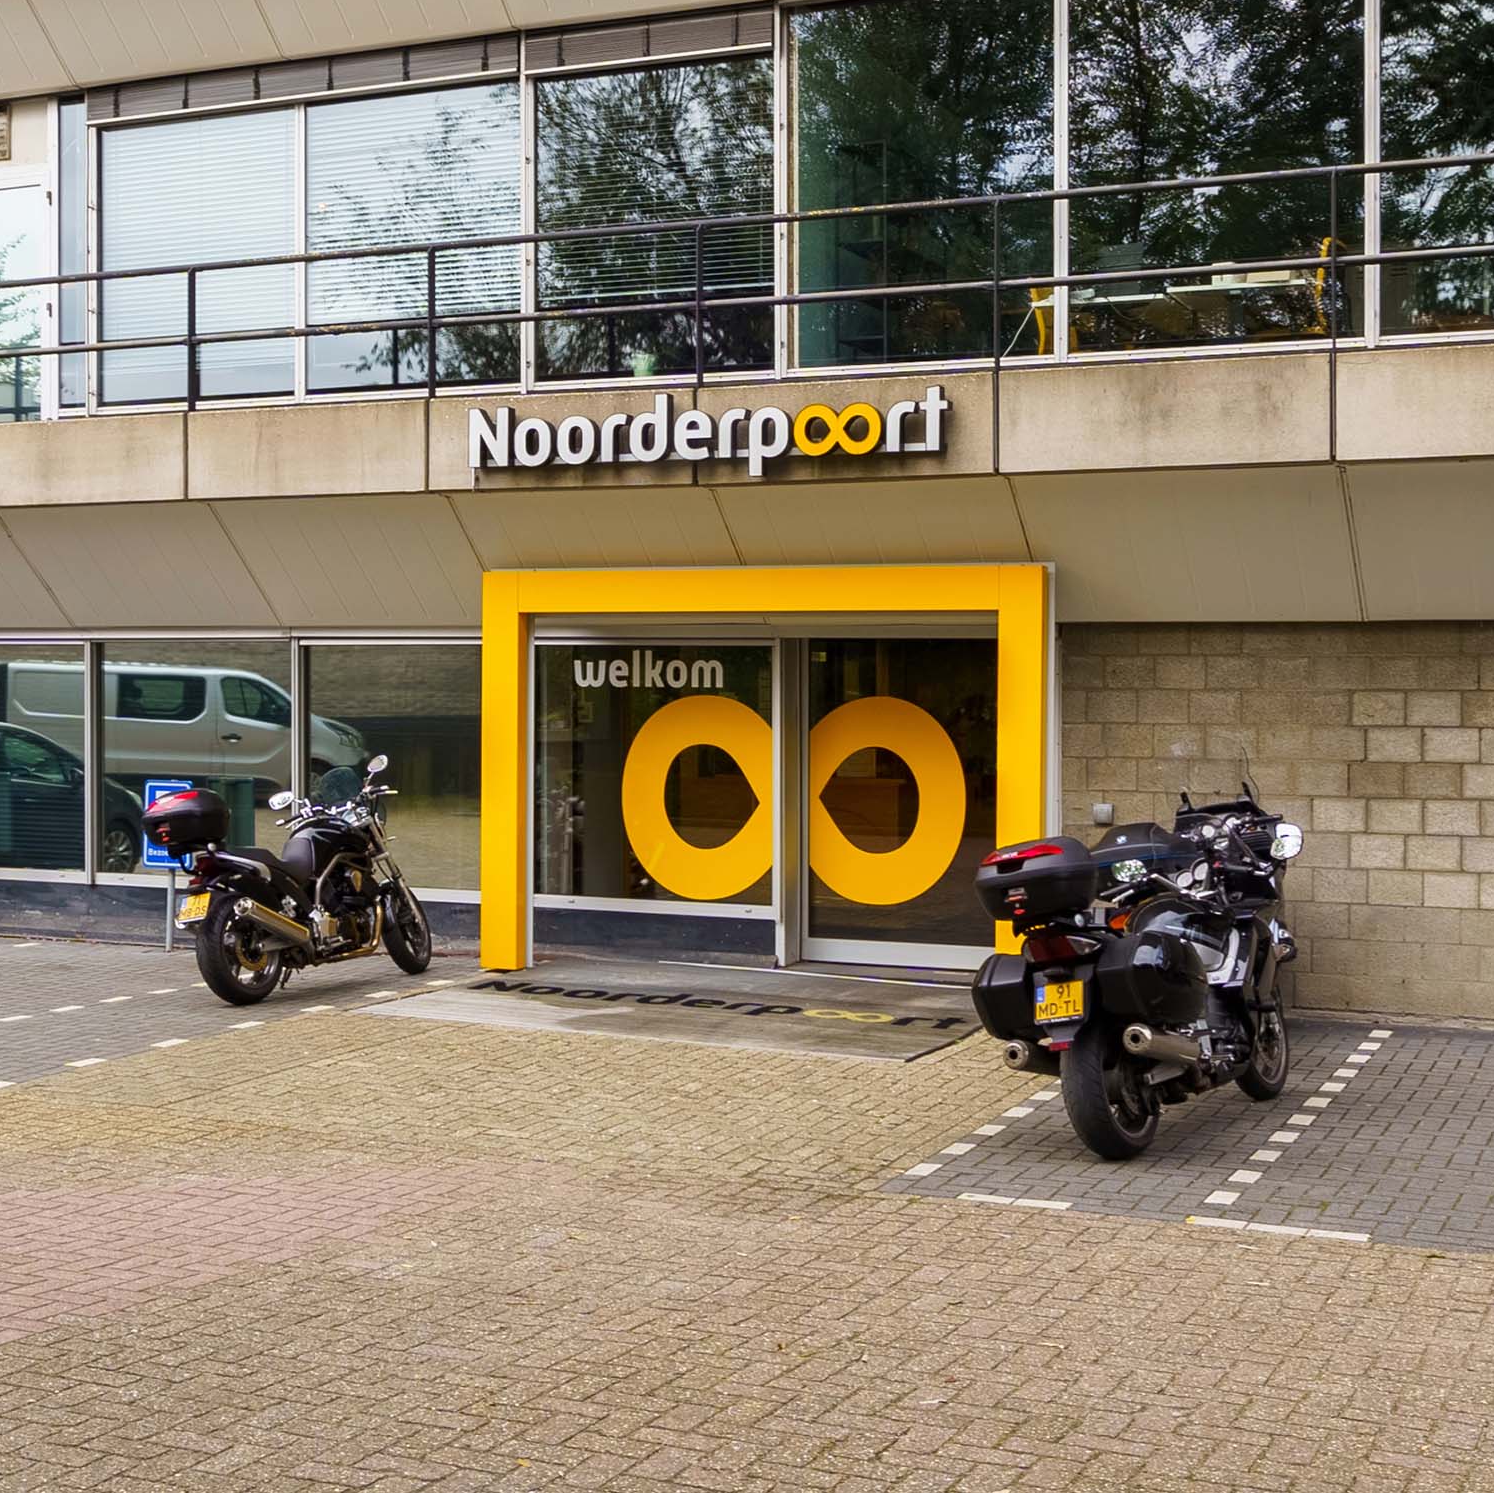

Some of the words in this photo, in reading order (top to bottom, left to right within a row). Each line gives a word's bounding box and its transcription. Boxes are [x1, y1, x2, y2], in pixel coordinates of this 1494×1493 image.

[468, 385, 950, 477] Noorderpoort
[573, 649, 724, 688] welkom
[467, 979, 968, 1030] Noorderpoort
[1038, 999, 1081, 1018] MD-TL
[1056, 984, 1071, 999] 91
